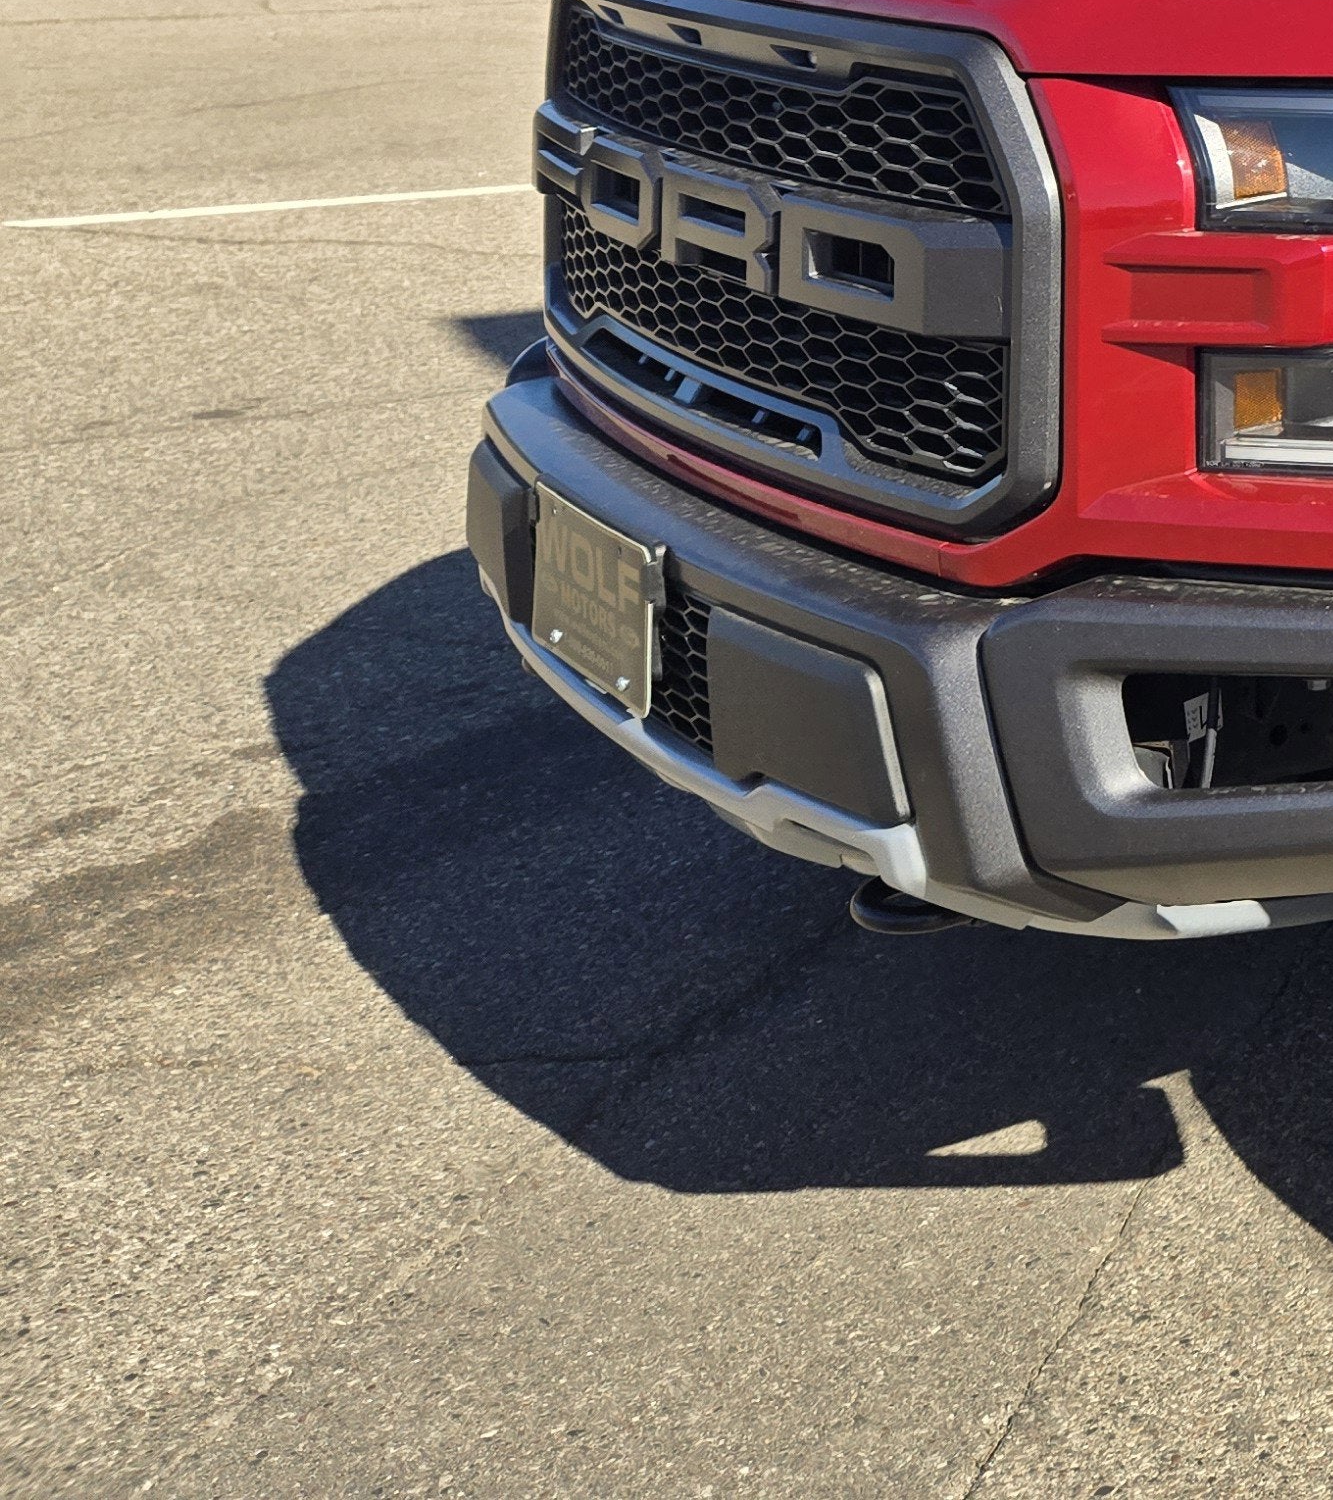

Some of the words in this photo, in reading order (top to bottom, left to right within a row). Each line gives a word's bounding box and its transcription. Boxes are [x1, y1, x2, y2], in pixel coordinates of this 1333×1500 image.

[532, 98, 925, 336] FORD
[536, 514, 640, 613] WOLF
[560, 585, 616, 639] MOTORS
